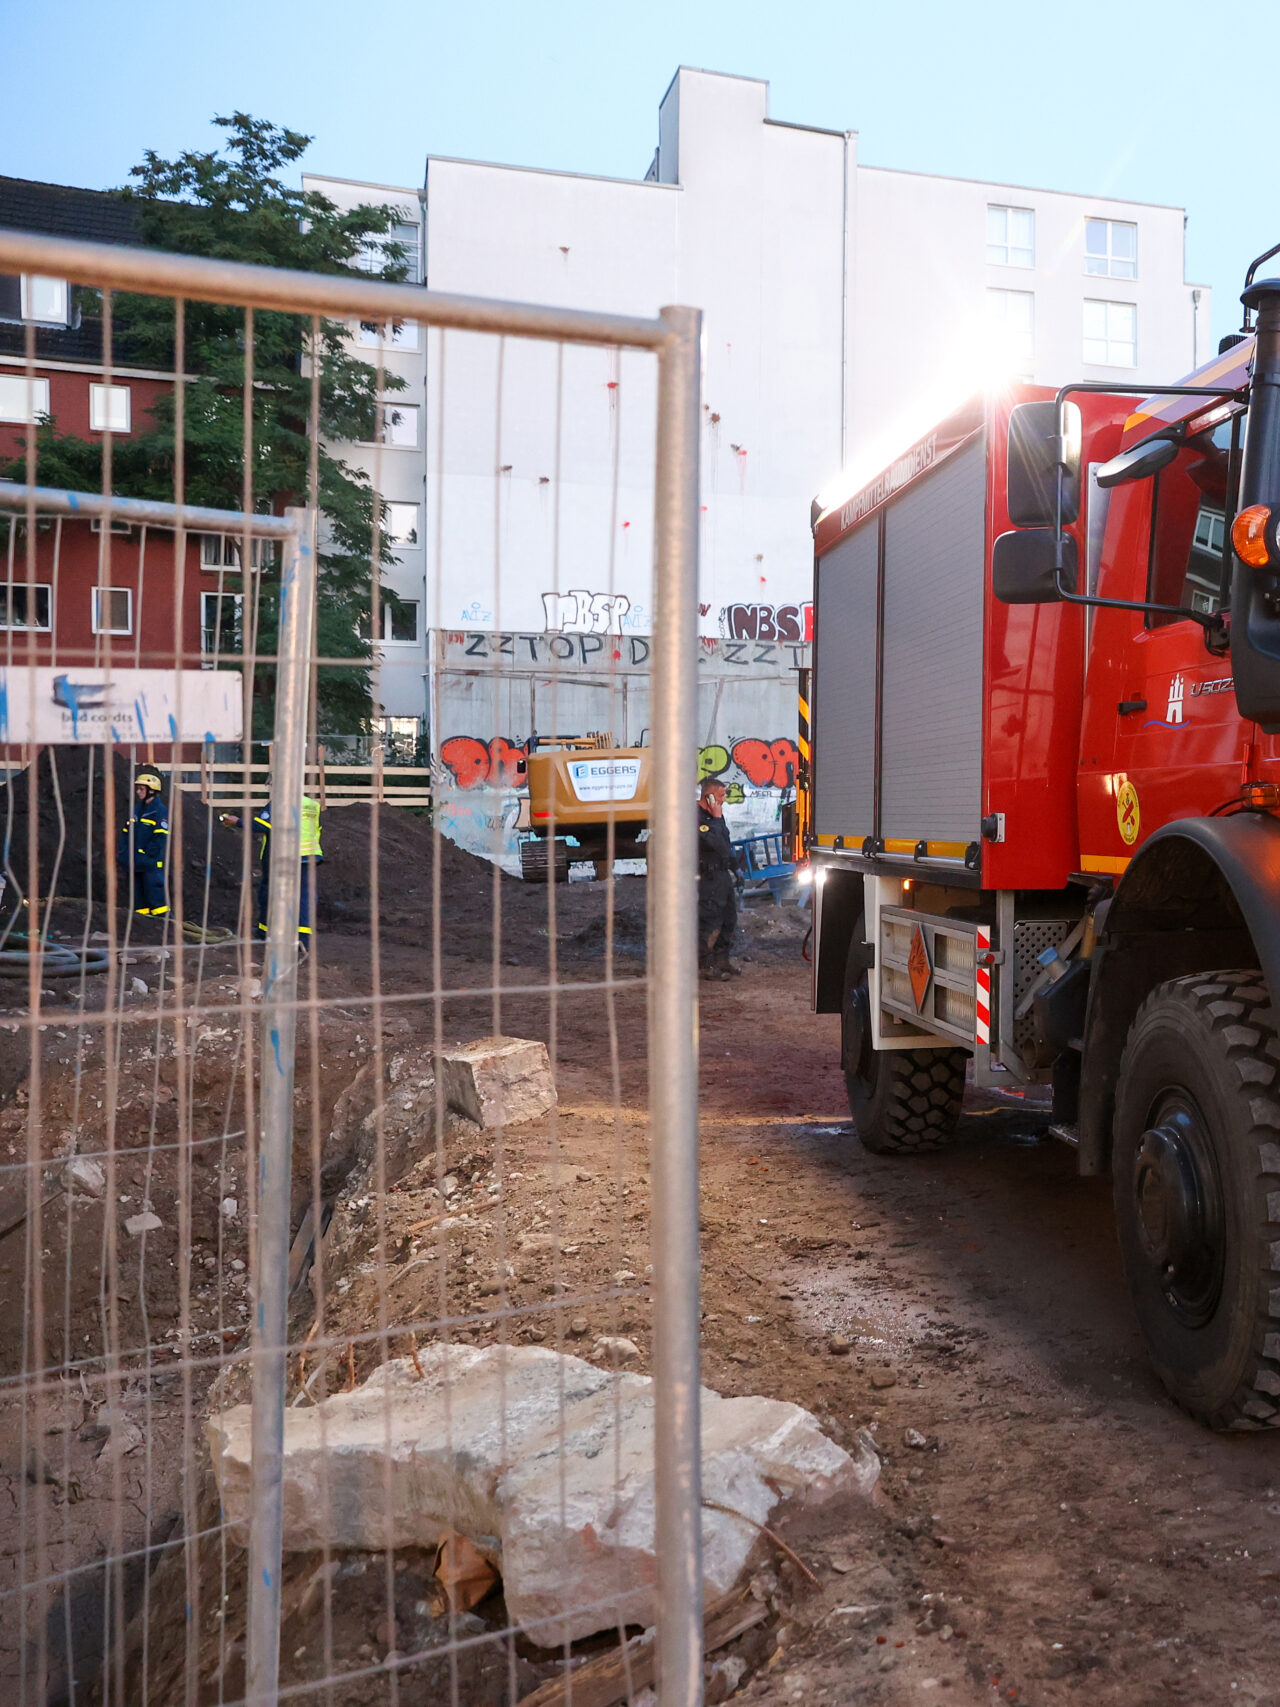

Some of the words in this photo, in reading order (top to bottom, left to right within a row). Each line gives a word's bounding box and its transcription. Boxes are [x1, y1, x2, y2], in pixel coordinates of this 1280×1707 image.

[1190, 677, 1235, 697] U502
[90, 711, 133, 722] codts
[590, 765, 637, 776] EGGERS
